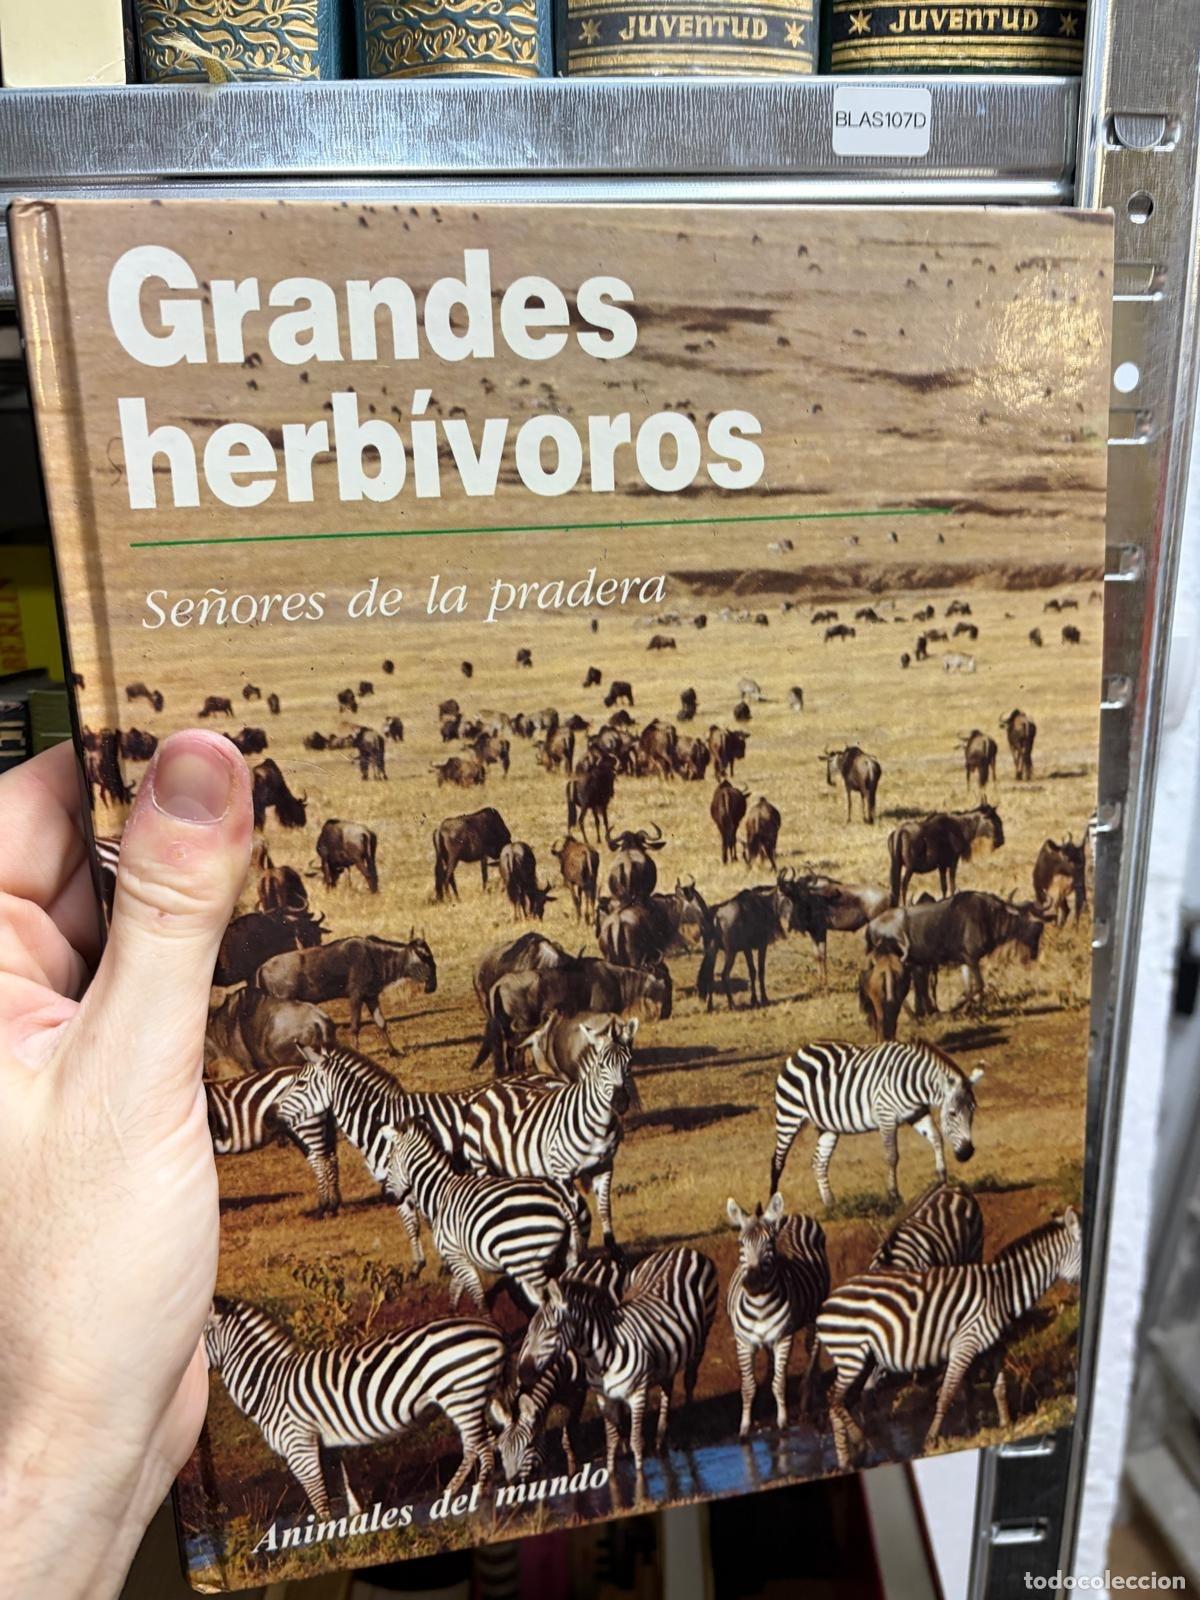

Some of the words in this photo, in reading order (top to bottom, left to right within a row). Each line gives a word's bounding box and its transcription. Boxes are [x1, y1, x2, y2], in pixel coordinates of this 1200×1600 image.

[618, 14, 769, 42] JUVENTUD
[889, 8, 1039, 34] JUVENTUD
[835, 111, 927, 129] BLAS107D
[107, 244, 639, 368] Grandes
[117, 388, 766, 510] herbívoros
[141, 588, 326, 630] Señores
[347, 577, 403, 619] de
[425, 574, 468, 615] la
[482, 567, 667, 624] pradera
[251, 1502, 414, 1555] Animales
[429, 1485, 479, 1521] del
[495, 1463, 610, 1507] mundo
